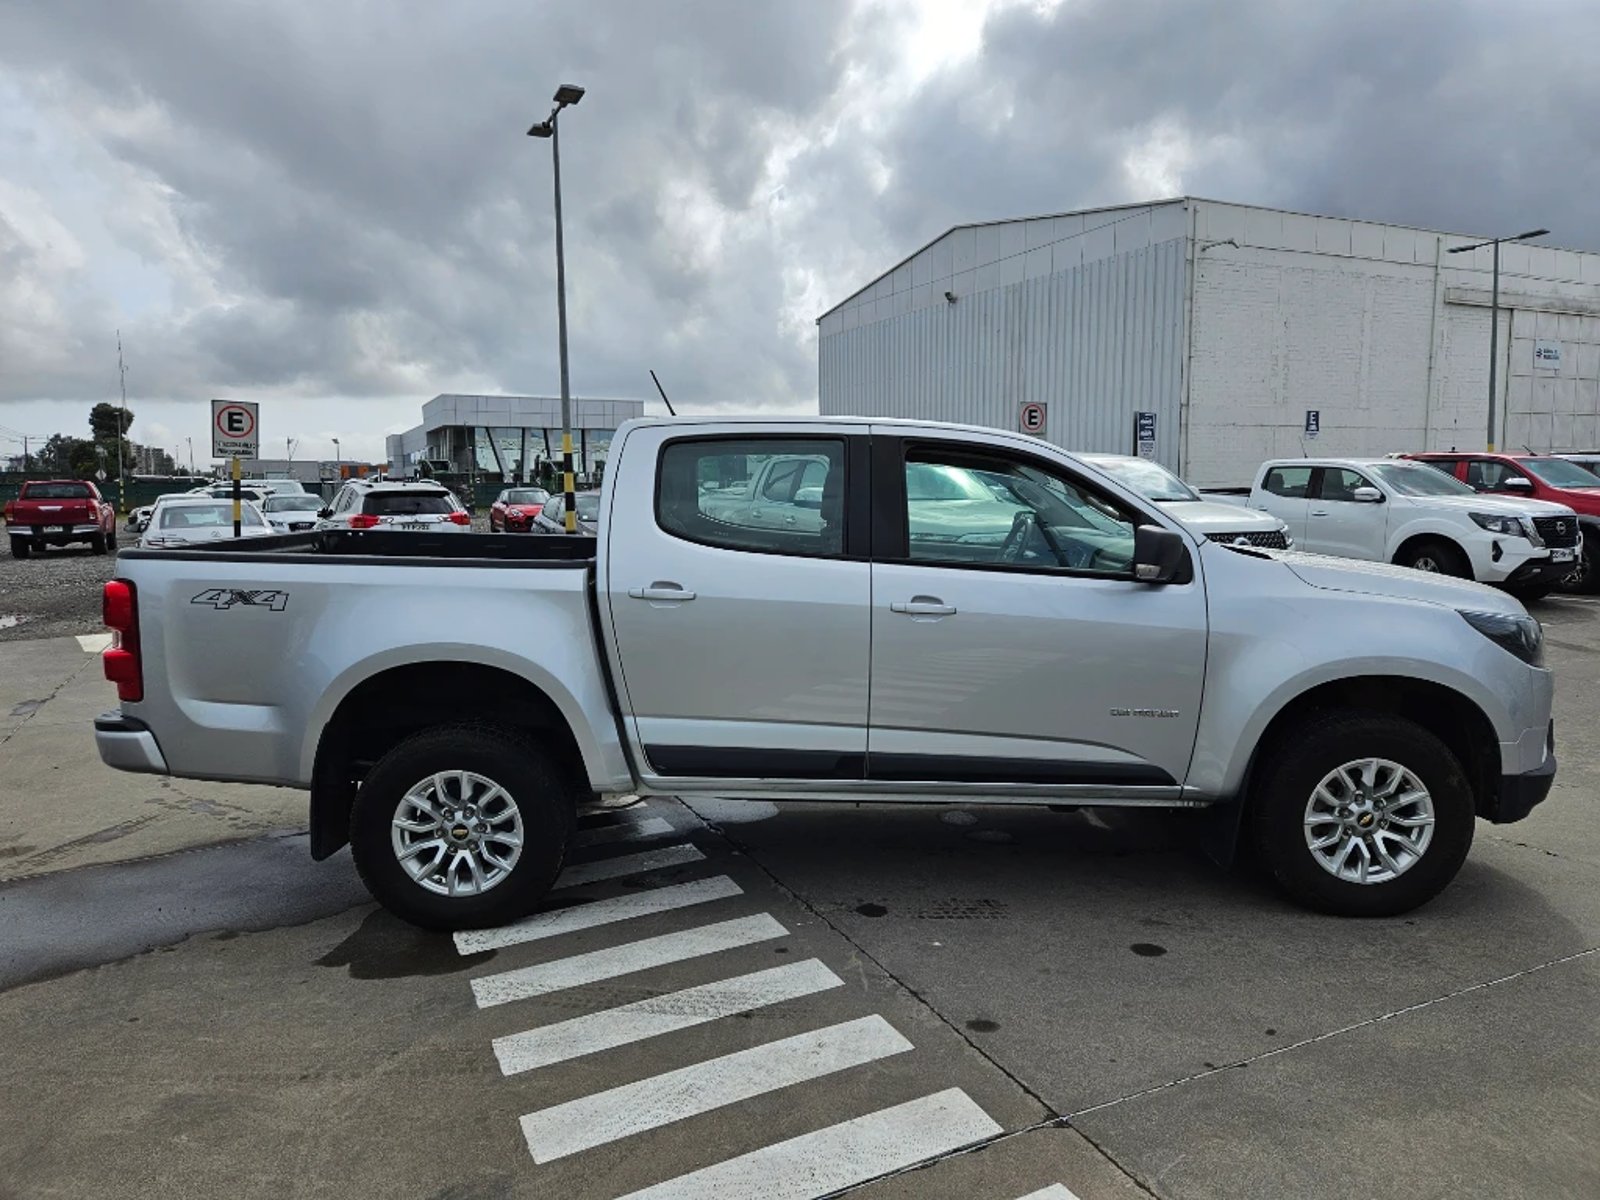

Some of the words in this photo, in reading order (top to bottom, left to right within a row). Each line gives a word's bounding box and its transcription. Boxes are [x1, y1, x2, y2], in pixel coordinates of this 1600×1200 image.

[228, 411, 244, 432] E
[1028, 409, 1038, 425] E
[1309, 412, 1316, 424] E
